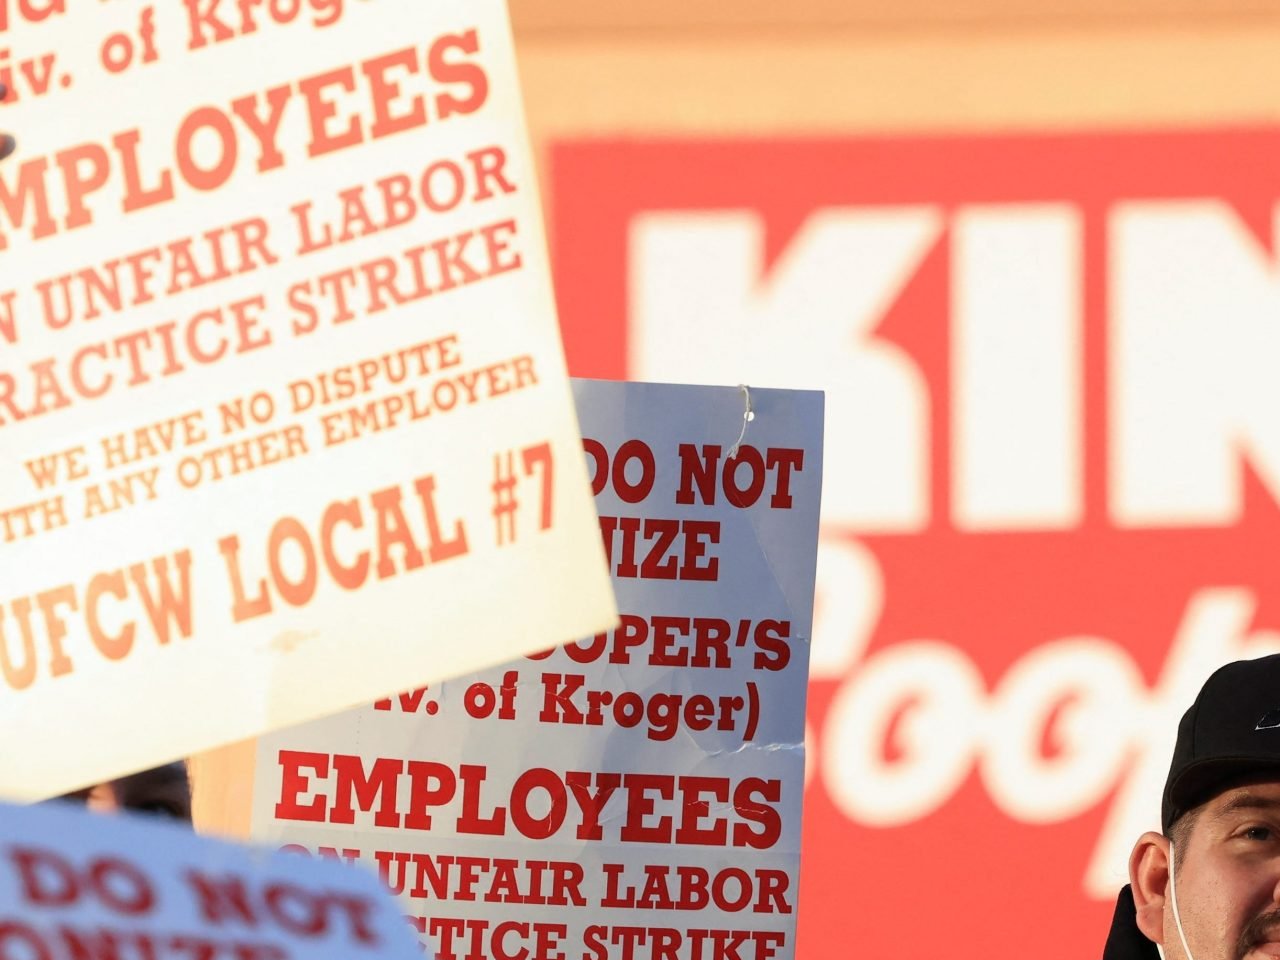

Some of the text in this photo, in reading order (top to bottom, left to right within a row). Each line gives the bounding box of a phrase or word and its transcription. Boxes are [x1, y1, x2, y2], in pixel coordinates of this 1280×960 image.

[100, 5, 160, 73] of
[0, 28, 490, 250] MPLOYEES
[34, 216, 278, 331] UNFAIR
[291, 145, 517, 256] LABOR
[0, 295, 272, 426] RACTICE
[287, 219, 523, 337] STRIKE
[0, 355, 539, 542] ITH ANY OTHER EMPLOYER
[25, 334, 462, 490] WE HAVE NO DISPUTE
[675, 443, 804, 509] NOT
[0, 441, 556, 691] UFCW LOCAL #7
[463, 670, 519, 721] of
[539, 672, 761, 742] Kroger)
[274, 749, 783, 851] EMPLOYEES
[7, 845, 386, 947] DO NOT
[375, 850, 587, 907] UNFAIR
[602, 862, 793, 916] LABOR
